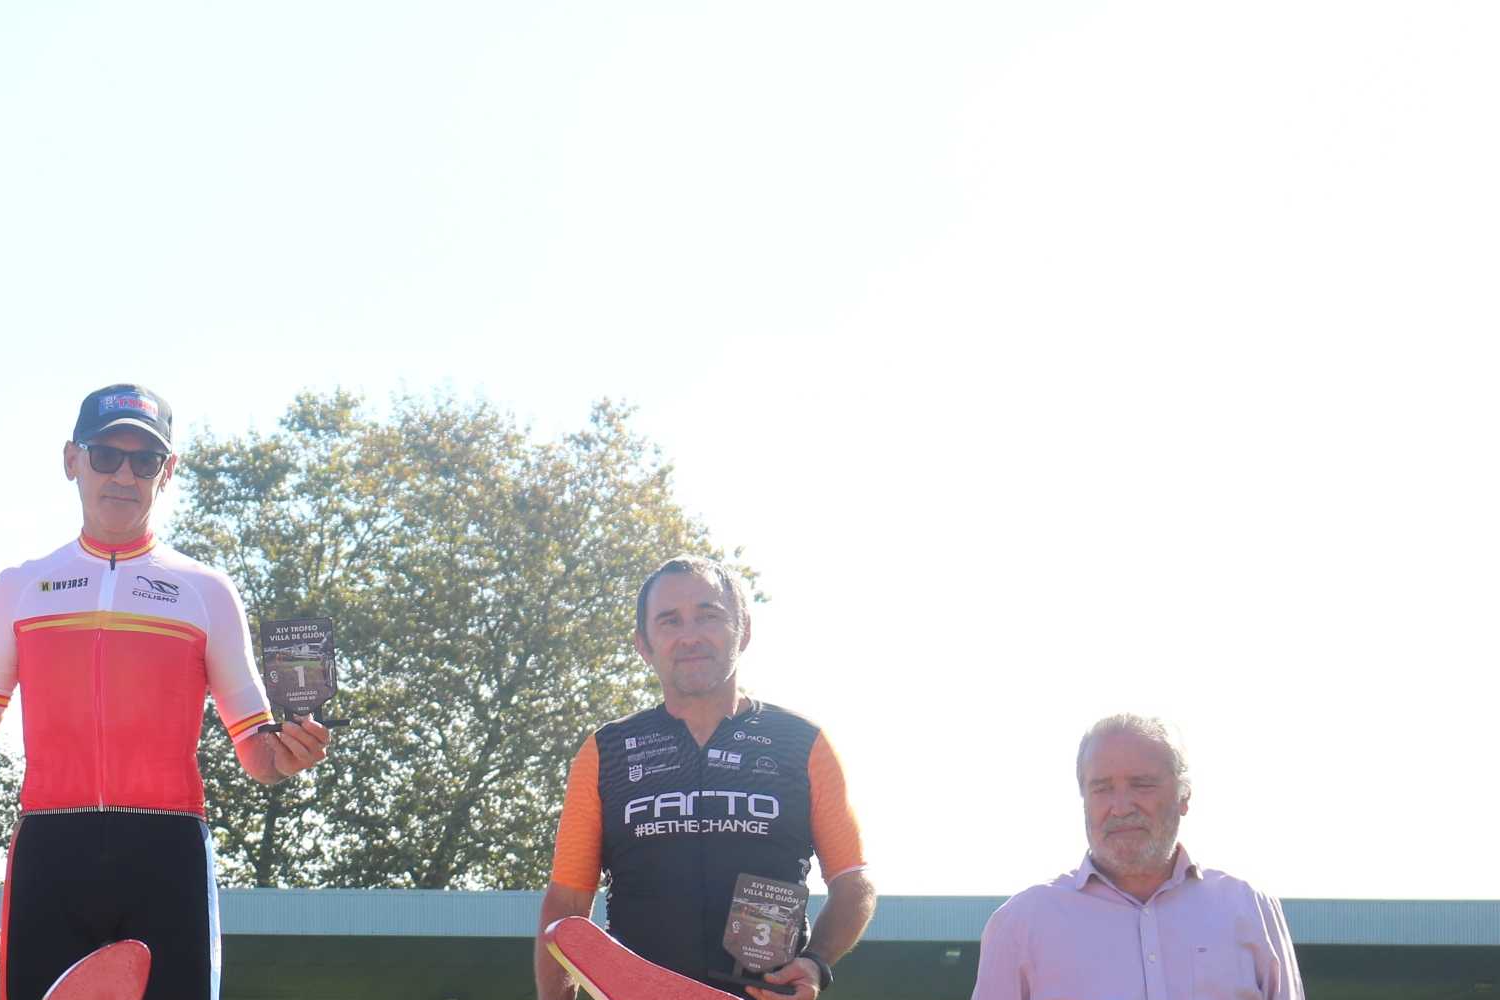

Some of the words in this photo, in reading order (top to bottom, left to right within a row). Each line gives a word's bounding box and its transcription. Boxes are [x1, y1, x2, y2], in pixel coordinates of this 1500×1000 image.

[132, 590, 177, 604] CICLISMO
[291, 625, 318, 633] TROFEO
[293, 666, 305, 688] 1
[743, 887, 763, 897] VILLA
[751, 882, 765, 890] XIV
[766, 884, 794, 895] TROFEO
[752, 923, 771, 946] 3
